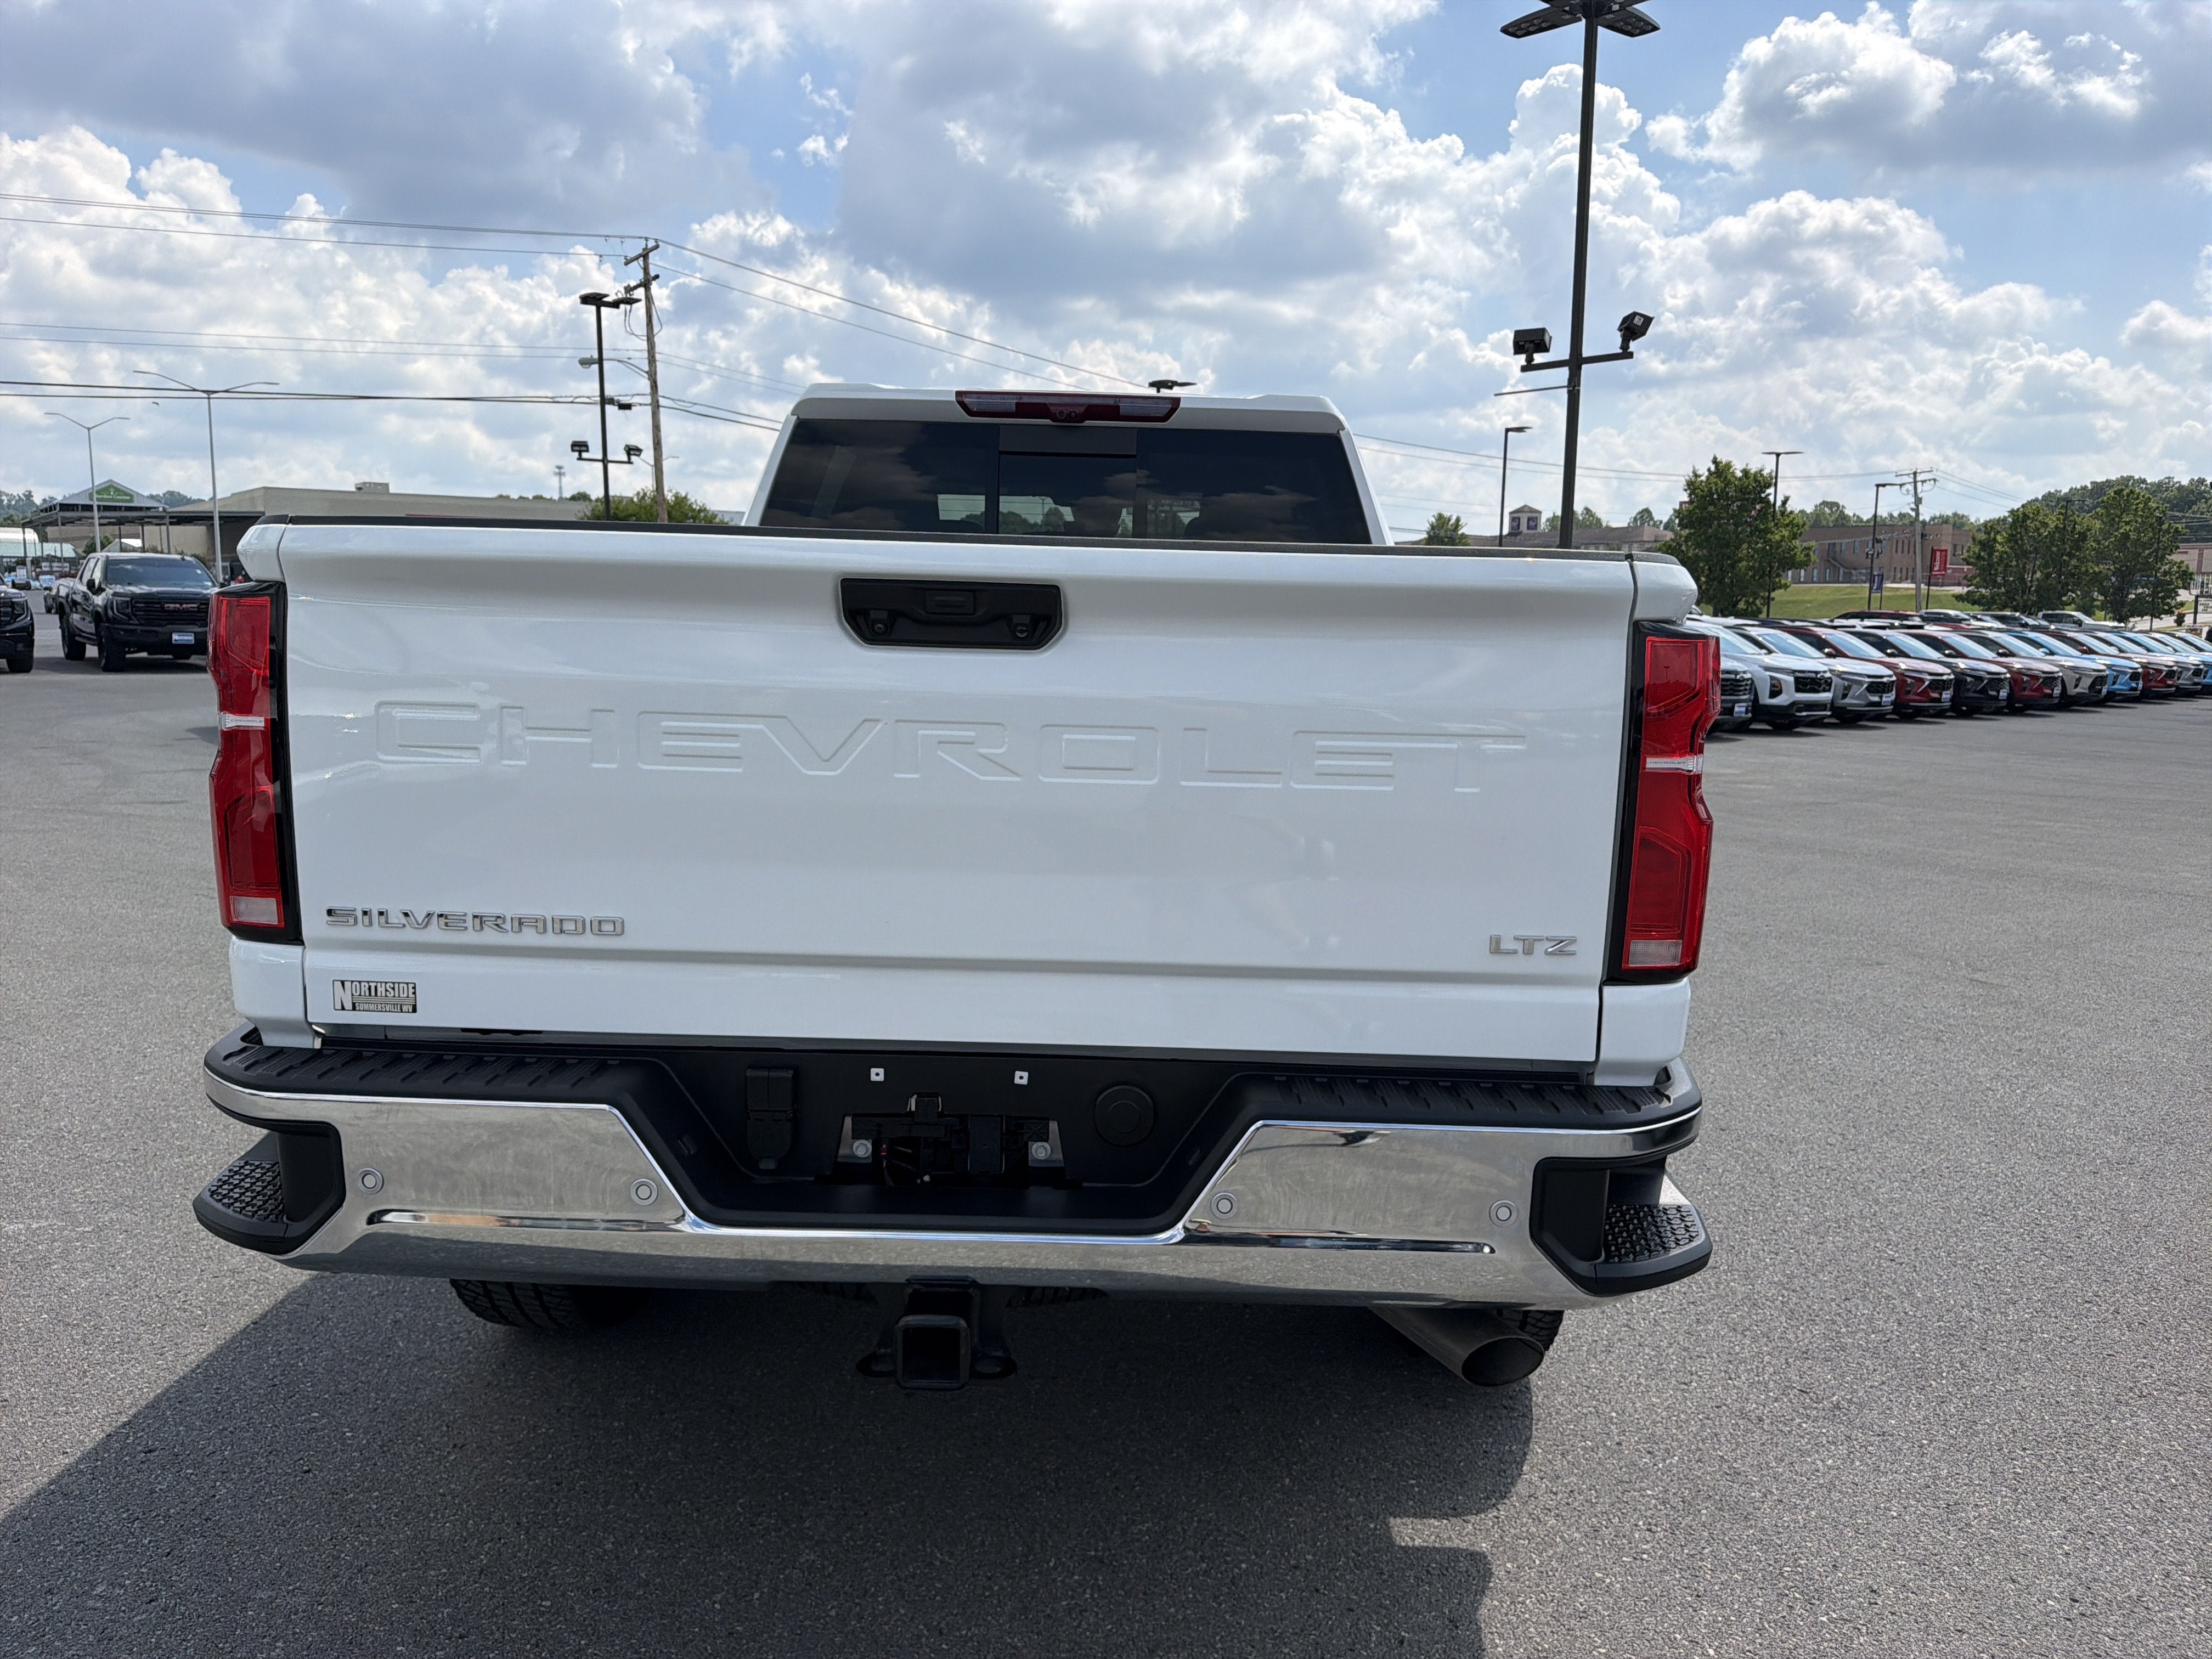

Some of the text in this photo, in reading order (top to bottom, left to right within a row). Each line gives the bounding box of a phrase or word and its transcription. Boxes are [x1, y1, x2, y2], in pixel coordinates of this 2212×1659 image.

[375, 699, 1527, 793] CHEVROLET
[325, 906, 624, 936] SILVERADO
[1489, 934, 1577, 955] LTZ
[333, 980, 415, 1010] NORTHSIDE
[355, 1002, 401, 1012] SUMMERSVILLE
